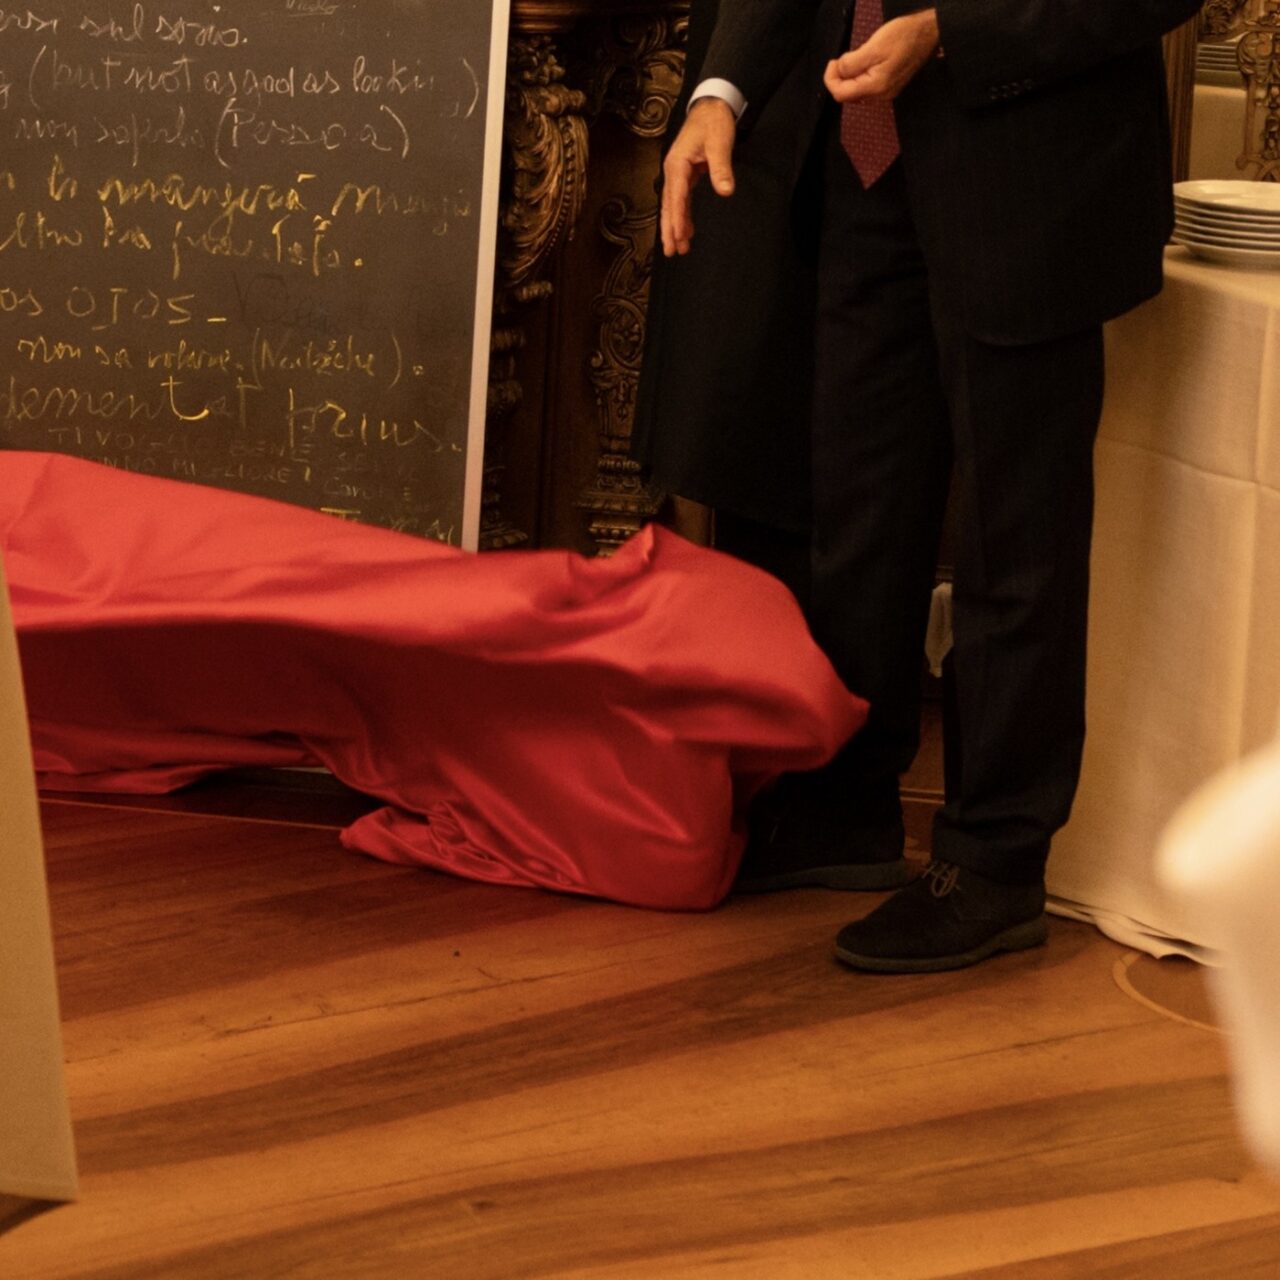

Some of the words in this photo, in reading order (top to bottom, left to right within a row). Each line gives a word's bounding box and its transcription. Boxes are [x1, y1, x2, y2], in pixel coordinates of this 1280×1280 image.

[80, 2, 145, 43] sul
[124, 54, 196, 94] not
[205, 69, 237, 98] as
[243, 66, 296, 111] good
[303, 69, 342, 96] as
[16, 116, 79, 147] non
[215, 97, 411, 169] (Pessoa)
[17, 334, 82, 364] non
[95, 344, 133, 370] sa
